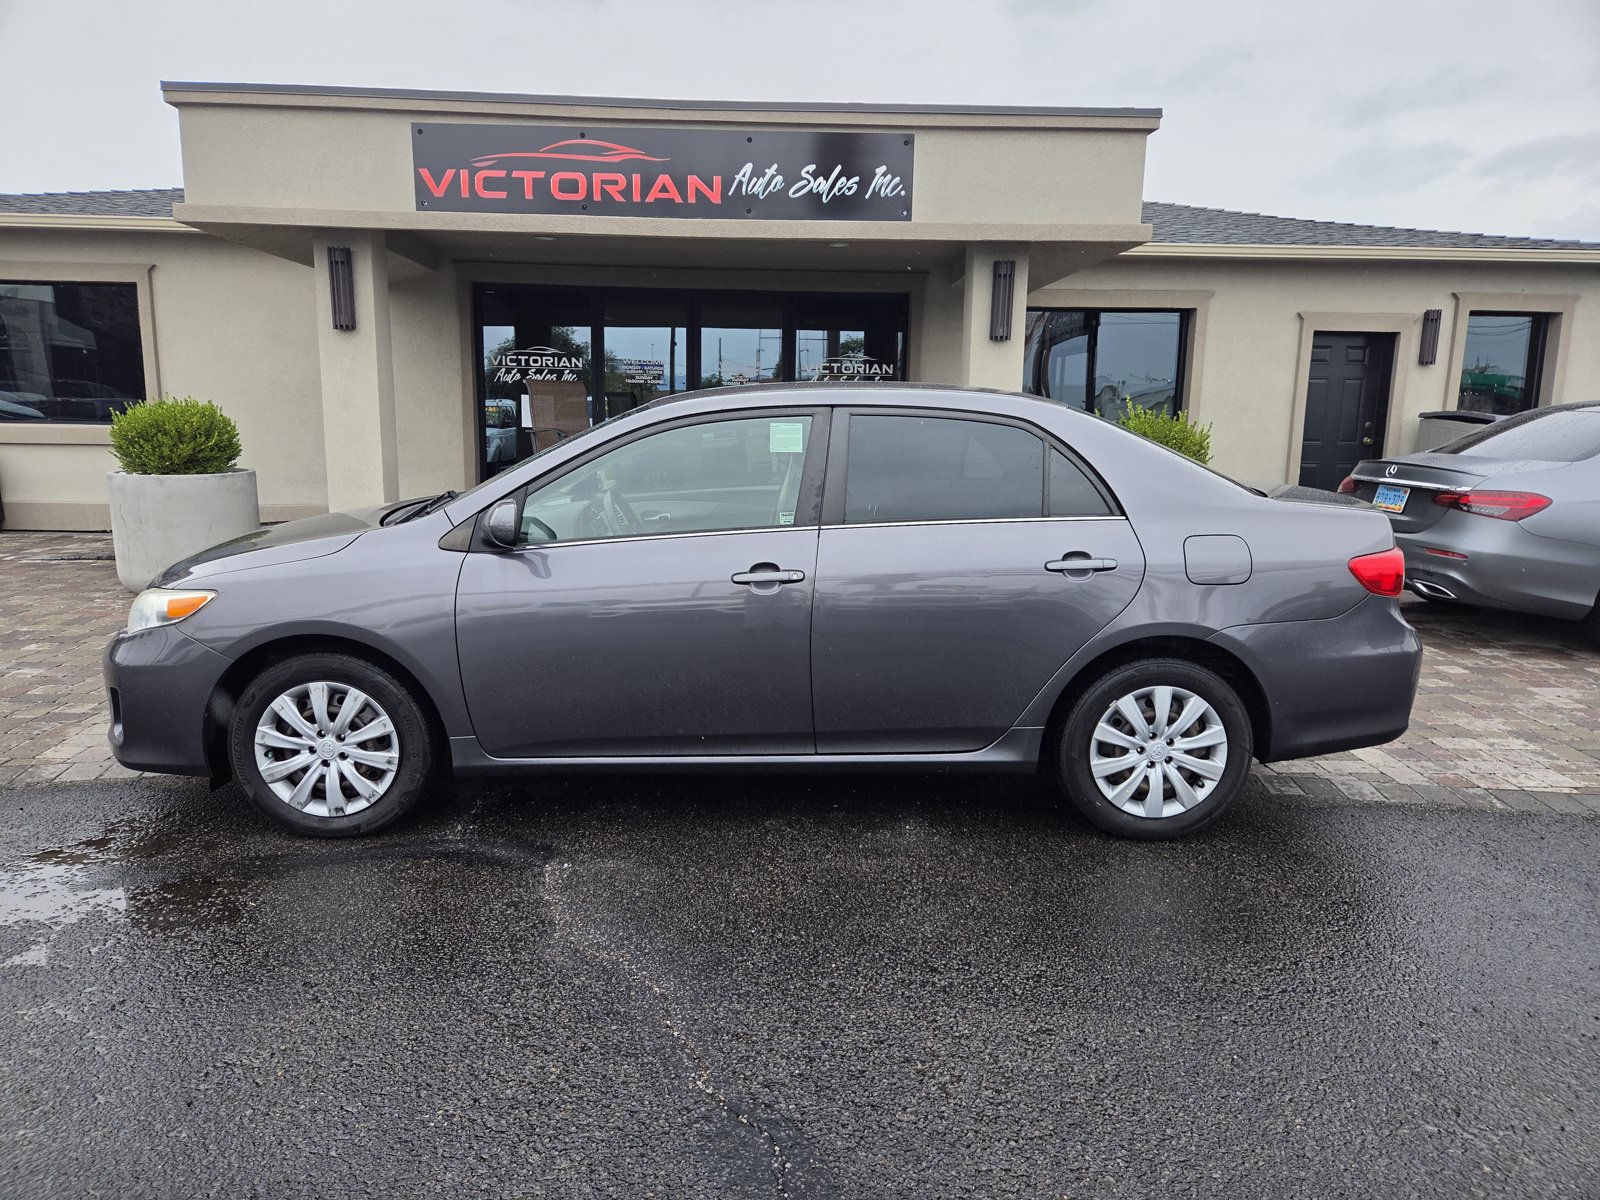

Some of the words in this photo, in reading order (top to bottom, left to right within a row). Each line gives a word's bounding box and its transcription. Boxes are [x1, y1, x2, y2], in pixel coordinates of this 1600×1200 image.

[418, 167, 722, 204] VICTORIAN
[728, 162, 785, 200] Auto
[788, 164, 860, 204] Sales
[865, 165, 906, 200] Inc.
[490, 355, 583, 370] VICTORIAN
[804, 363, 894, 374] VICTORIAN
[494, 368, 521, 384] Auto
[561, 370, 579, 382] Inc
